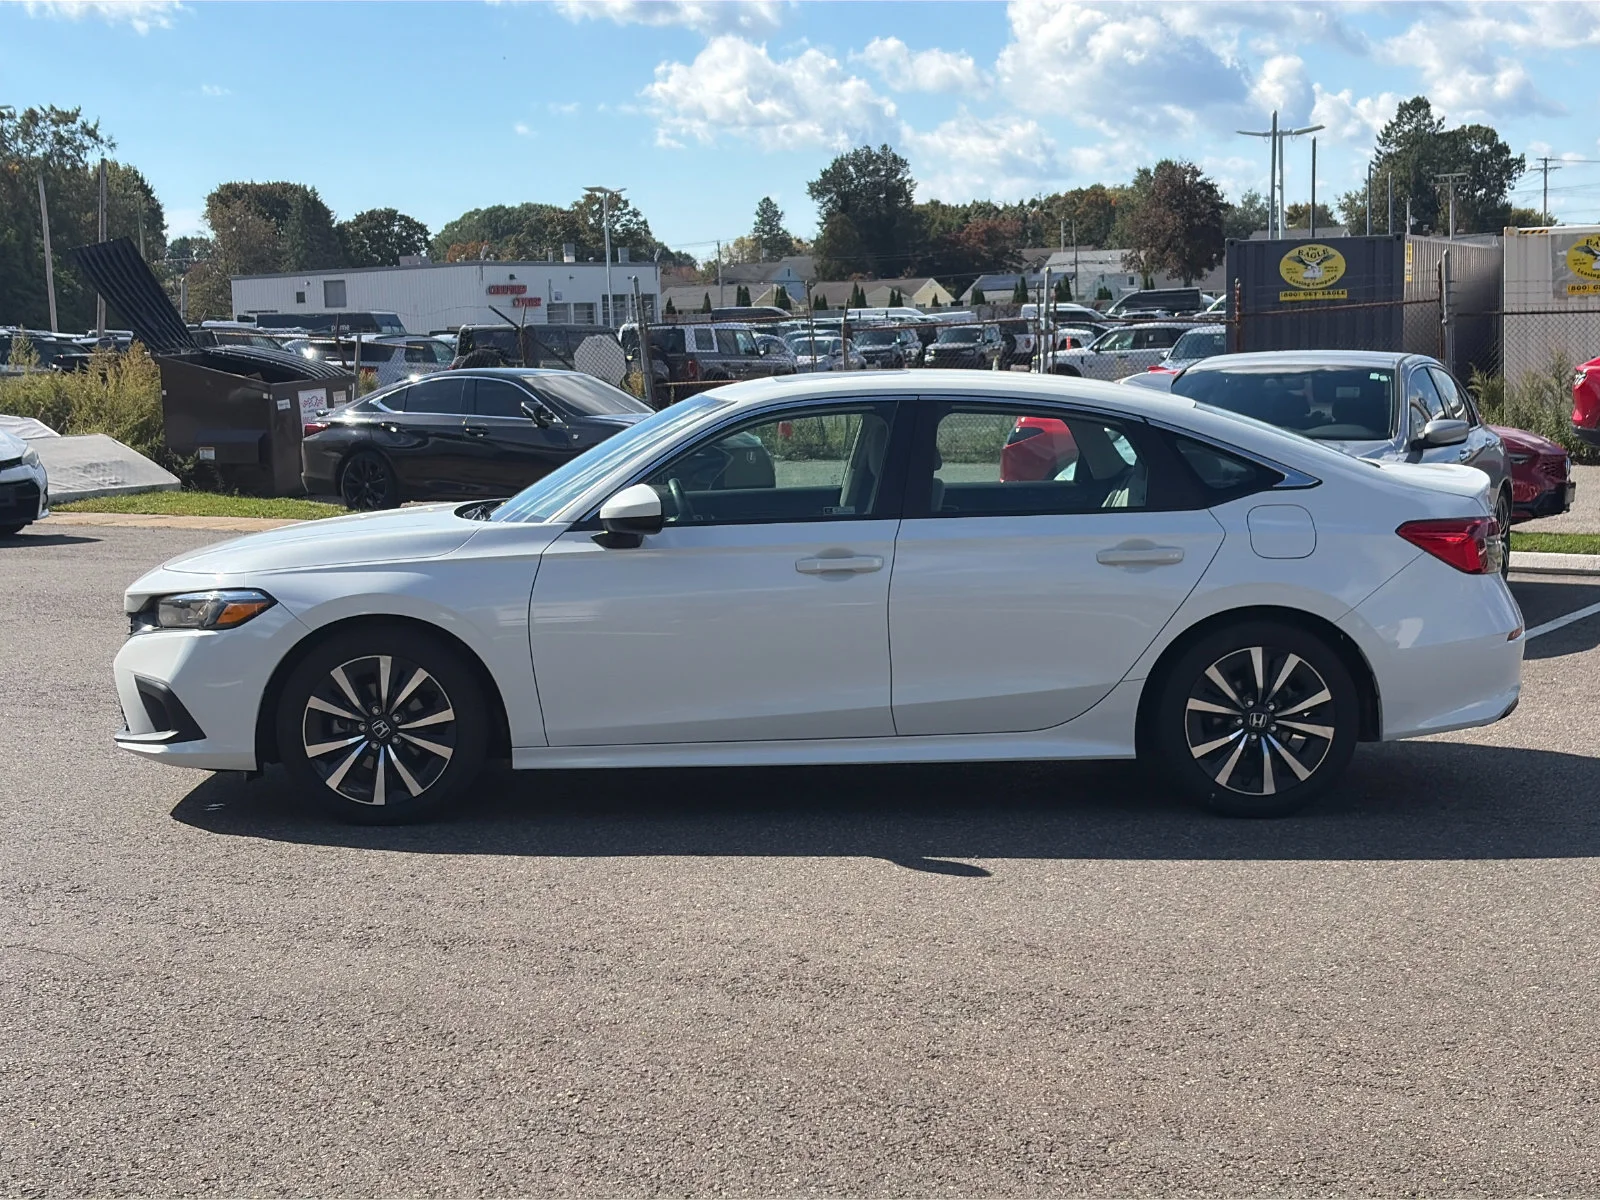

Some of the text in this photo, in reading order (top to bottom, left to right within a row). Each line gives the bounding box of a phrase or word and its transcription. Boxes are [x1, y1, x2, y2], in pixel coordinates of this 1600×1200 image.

[1298, 248, 1329, 258] EAGLE
[1289, 274, 1337, 287] Leasing Company
[331, 324, 350, 333] pme
